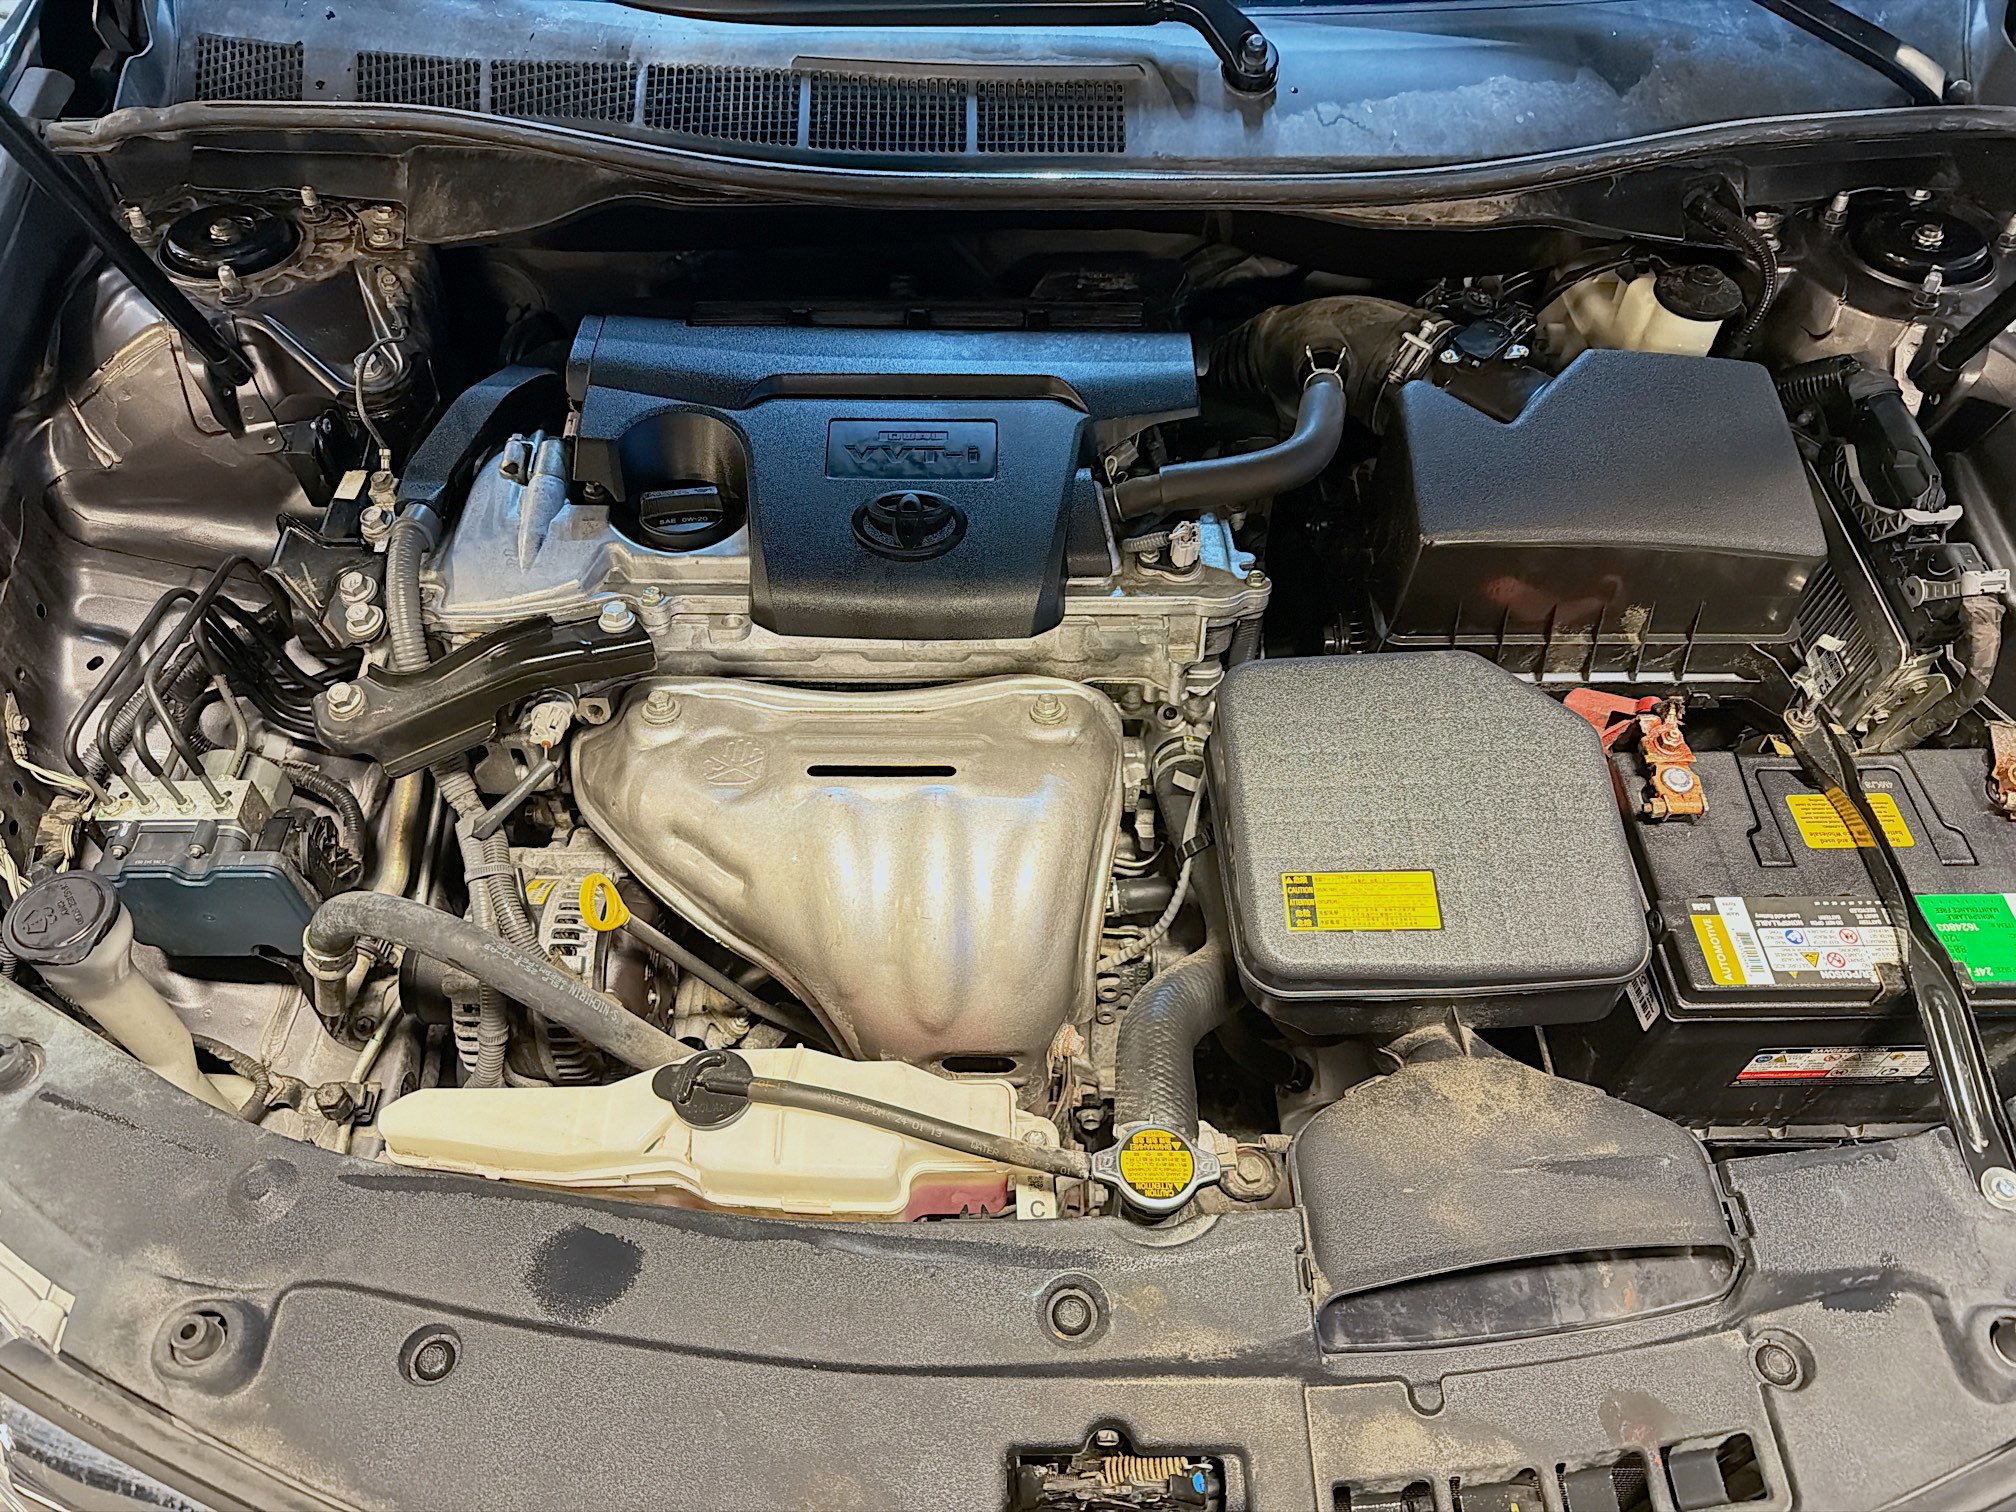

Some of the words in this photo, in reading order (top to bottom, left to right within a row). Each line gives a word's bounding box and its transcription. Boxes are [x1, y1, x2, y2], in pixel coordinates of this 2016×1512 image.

[844, 445, 981, 464] VVT-i
[1820, 679, 1832, 696] CA
[1936, 922, 1980, 931] 1624803
[1702, 918, 1734, 981] AUTOMOTIVE
[1974, 967, 1994, 976] 24F
[818, 1092, 850, 1108] WATER
[894, 1114, 908, 1125] 24
[911, 1122, 924, 1132] 01
[930, 1128, 944, 1138] 13
[970, 1140, 999, 1157] WATER
[1044, 1162, 1056, 1172] 24
[1060, 1166, 1071, 1175] 01
[1030, 1200, 1045, 1218] C
